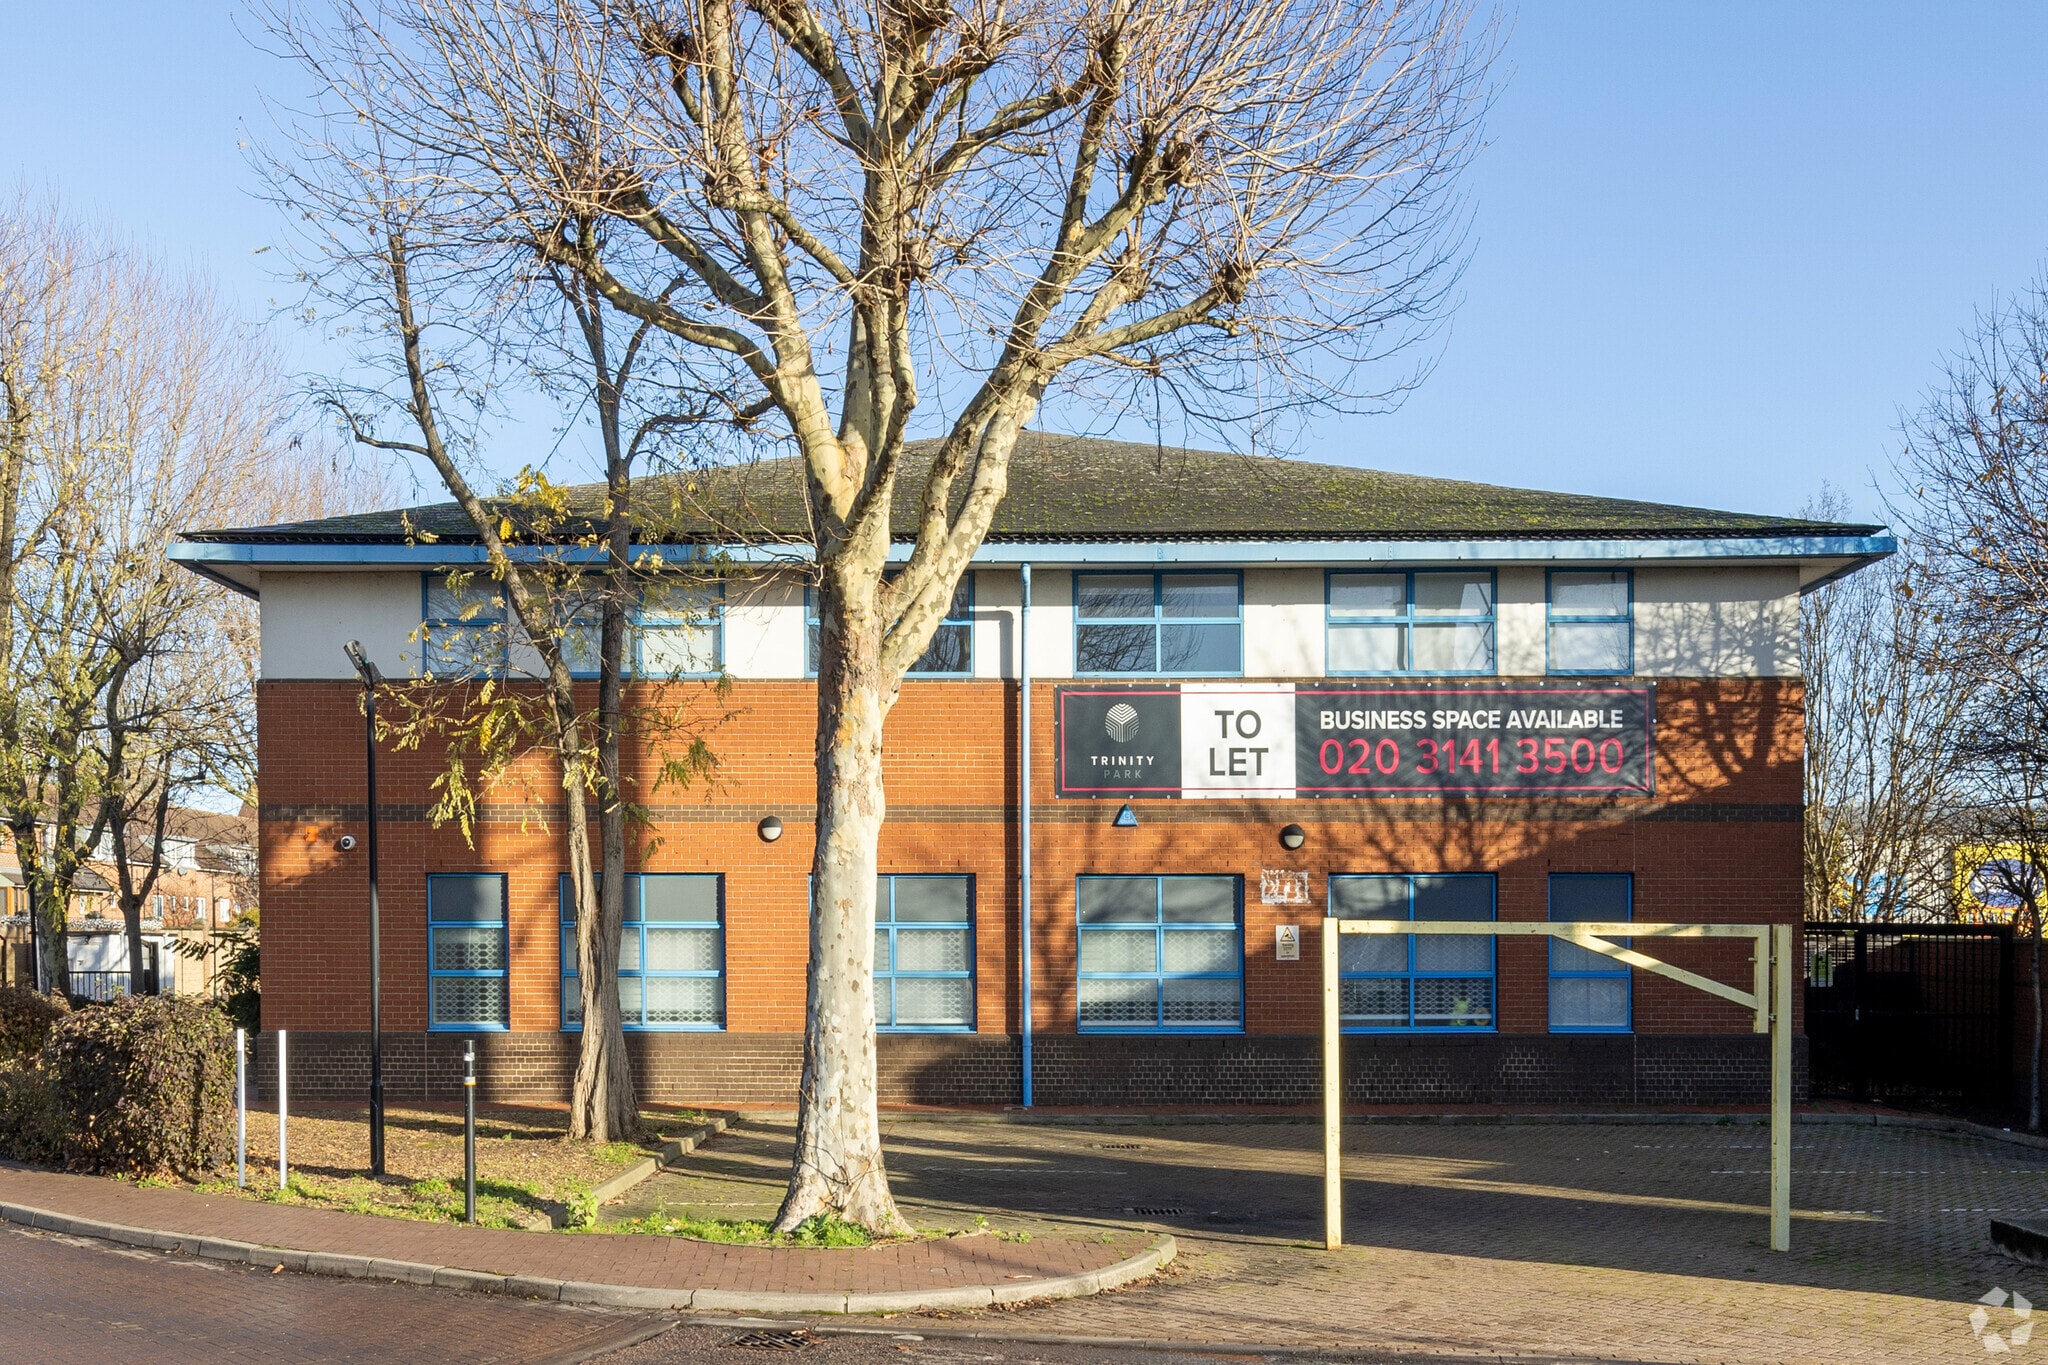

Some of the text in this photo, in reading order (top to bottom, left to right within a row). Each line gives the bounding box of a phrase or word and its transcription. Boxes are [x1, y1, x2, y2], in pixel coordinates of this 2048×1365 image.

[1213, 709, 1262, 739] TO
[1319, 708, 1623, 730] BUSINESS SPACE AVAILABLE
[1090, 755, 1155, 766] TRINITY
[1208, 746, 1270, 777] LET
[1319, 736, 1625, 775] 020 3141 3500
[1103, 769, 1143, 779] PARK
